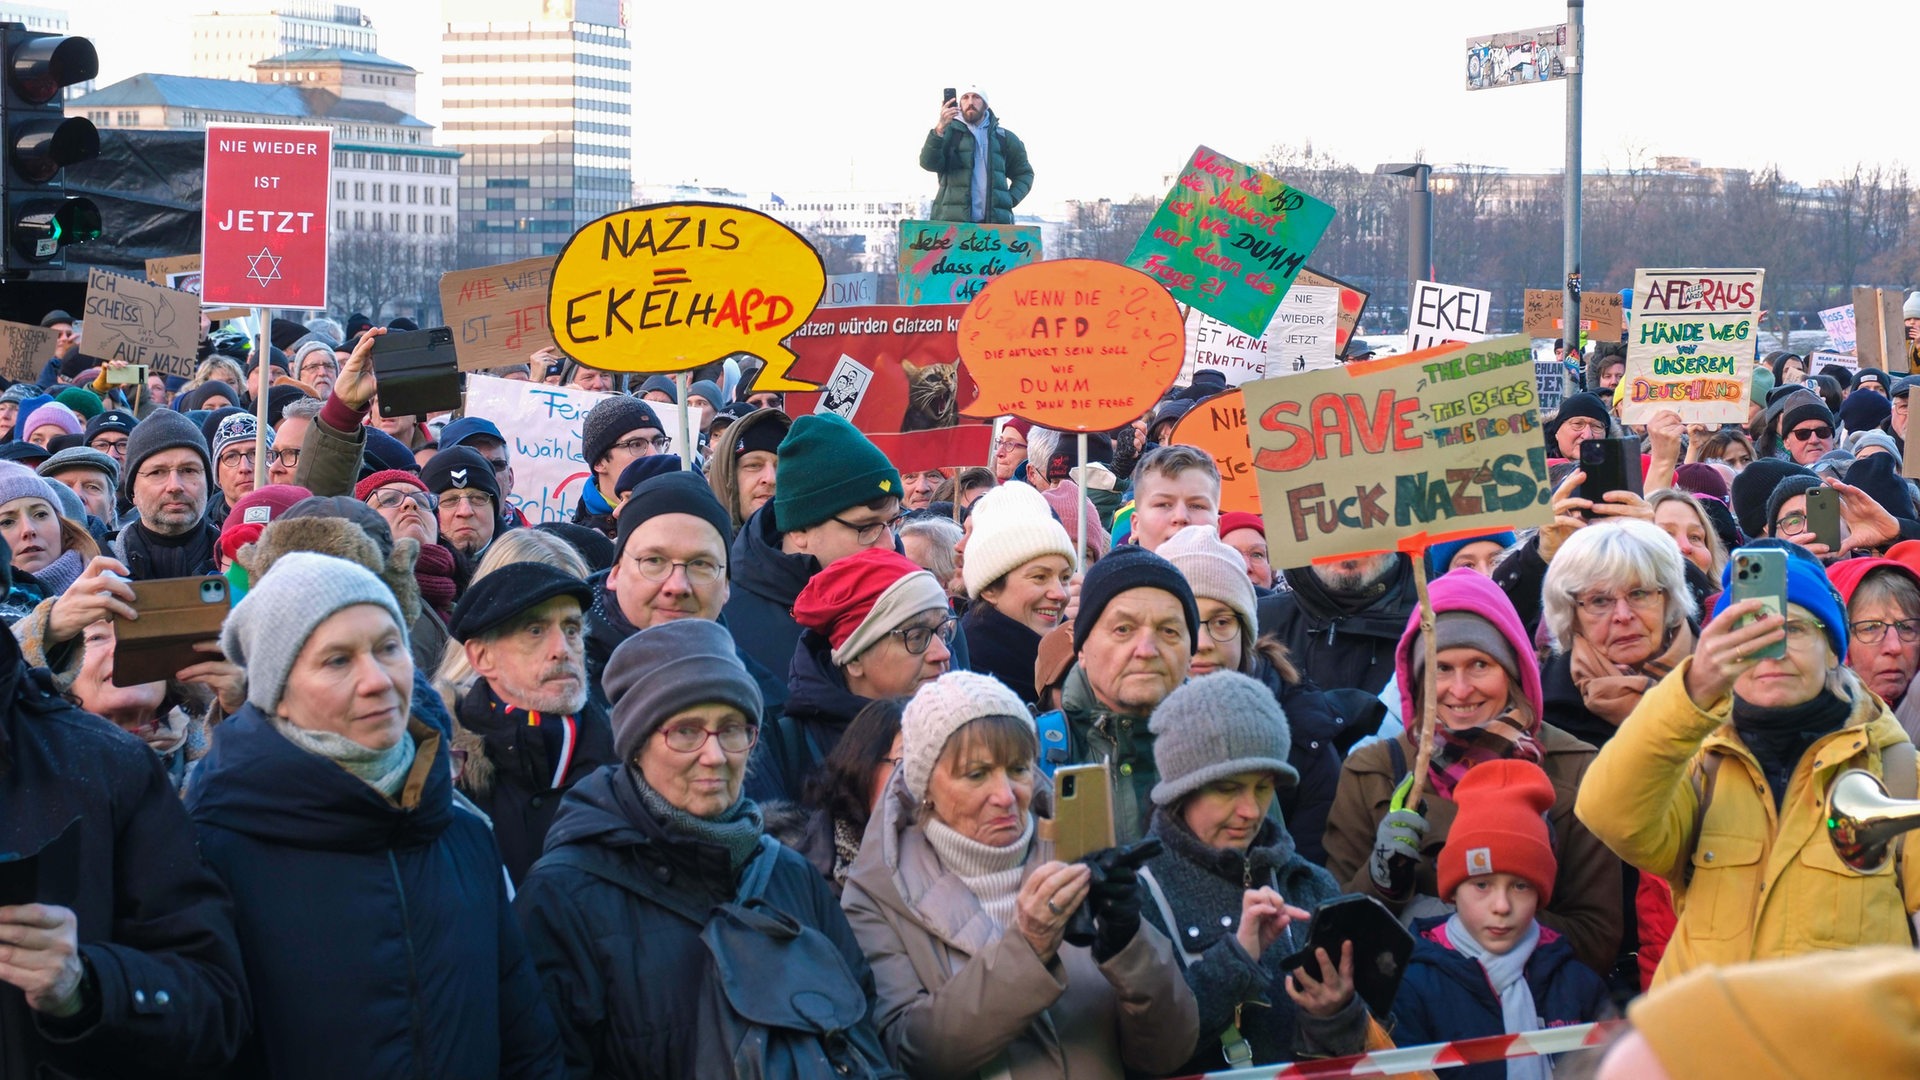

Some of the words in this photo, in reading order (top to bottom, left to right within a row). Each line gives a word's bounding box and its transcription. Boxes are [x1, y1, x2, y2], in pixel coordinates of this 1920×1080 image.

[219, 140, 247, 153] NIE
[253, 141, 317, 155] WIEDER
[254, 176, 280, 189] IST
[1192, 150, 1235, 183] Wenn
[1239, 175, 1264, 195] die
[1180, 172, 1204, 193] die
[1209, 187, 1286, 236] Antwort
[218, 209, 314, 233] JETZT
[601, 216, 740, 260] NAZIS
[960, 229, 1001, 252] stets
[1007, 239, 1032, 258] so,
[932, 255, 973, 276] dass
[980, 256, 1006, 276] die
[1153, 226, 1192, 247] war
[1193, 243, 1242, 277] dann
[1245, 271, 1275, 295] die
[1230, 232, 1305, 279] DUMM
[90, 273, 116, 293] ICH
[1143, 255, 1195, 290] Frage
[457, 278, 496, 306] NIE
[503, 267, 551, 292] WIED
[1014, 289, 1065, 307] WENN
[1075, 289, 1102, 306] DIE
[1643, 280, 1691, 310] AFD
[1695, 278, 1754, 312] RAUS
[86, 296, 139, 323] SCHEISS
[1294, 294, 1313, 304] NIE
[1417, 286, 1485, 334] EKEL
[462, 315, 492, 344] IST
[505, 305, 547, 350] JET
[793, 320, 835, 338] atzen
[839, 316, 889, 335] würden
[892, 316, 942, 335] Glatzen
[947, 315, 960, 332] kr
[1031, 316, 1089, 338] AFD
[1281, 314, 1325, 325] WIEDER
[1197, 327, 1222, 344] ST
[1226, 333, 1268, 354] KEINE
[1285, 334, 1318, 344] JETZT
[1639, 322, 1704, 344] HÄNDE
[1709, 320, 1750, 341] WEG
[113, 342, 147, 365] AUF
[151, 354, 193, 377] NAZIS
[984, 347, 1004, 360] DIE
[1008, 348, 1058, 358] ANTWORT
[1064, 348, 1095, 357] SEIN
[1197, 350, 1265, 374] ERNATIVE
[1654, 356, 1735, 375] UNSEREM
[1051, 364, 1075, 374] WIE
[1423, 361, 1466, 384] THE
[1535, 362, 1563, 375] CHLAN
[1021, 378, 1089, 394] DUMM
[1631, 379, 1741, 402] DEUTSCHLAND
[998, 401, 1027, 412] WAR
[1036, 400, 1064, 411] DANN
[1071, 399, 1091, 409] DIE
[1099, 397, 1135, 408] FRAGE
[1431, 399, 1465, 423] THE
[1469, 381, 1534, 415] BEES
[1254, 389, 1423, 472] SAVE
[1432, 425, 1474, 449] THE
[1476, 409, 1540, 440] PEOPLE
[1216, 456, 1255, 482] Je
